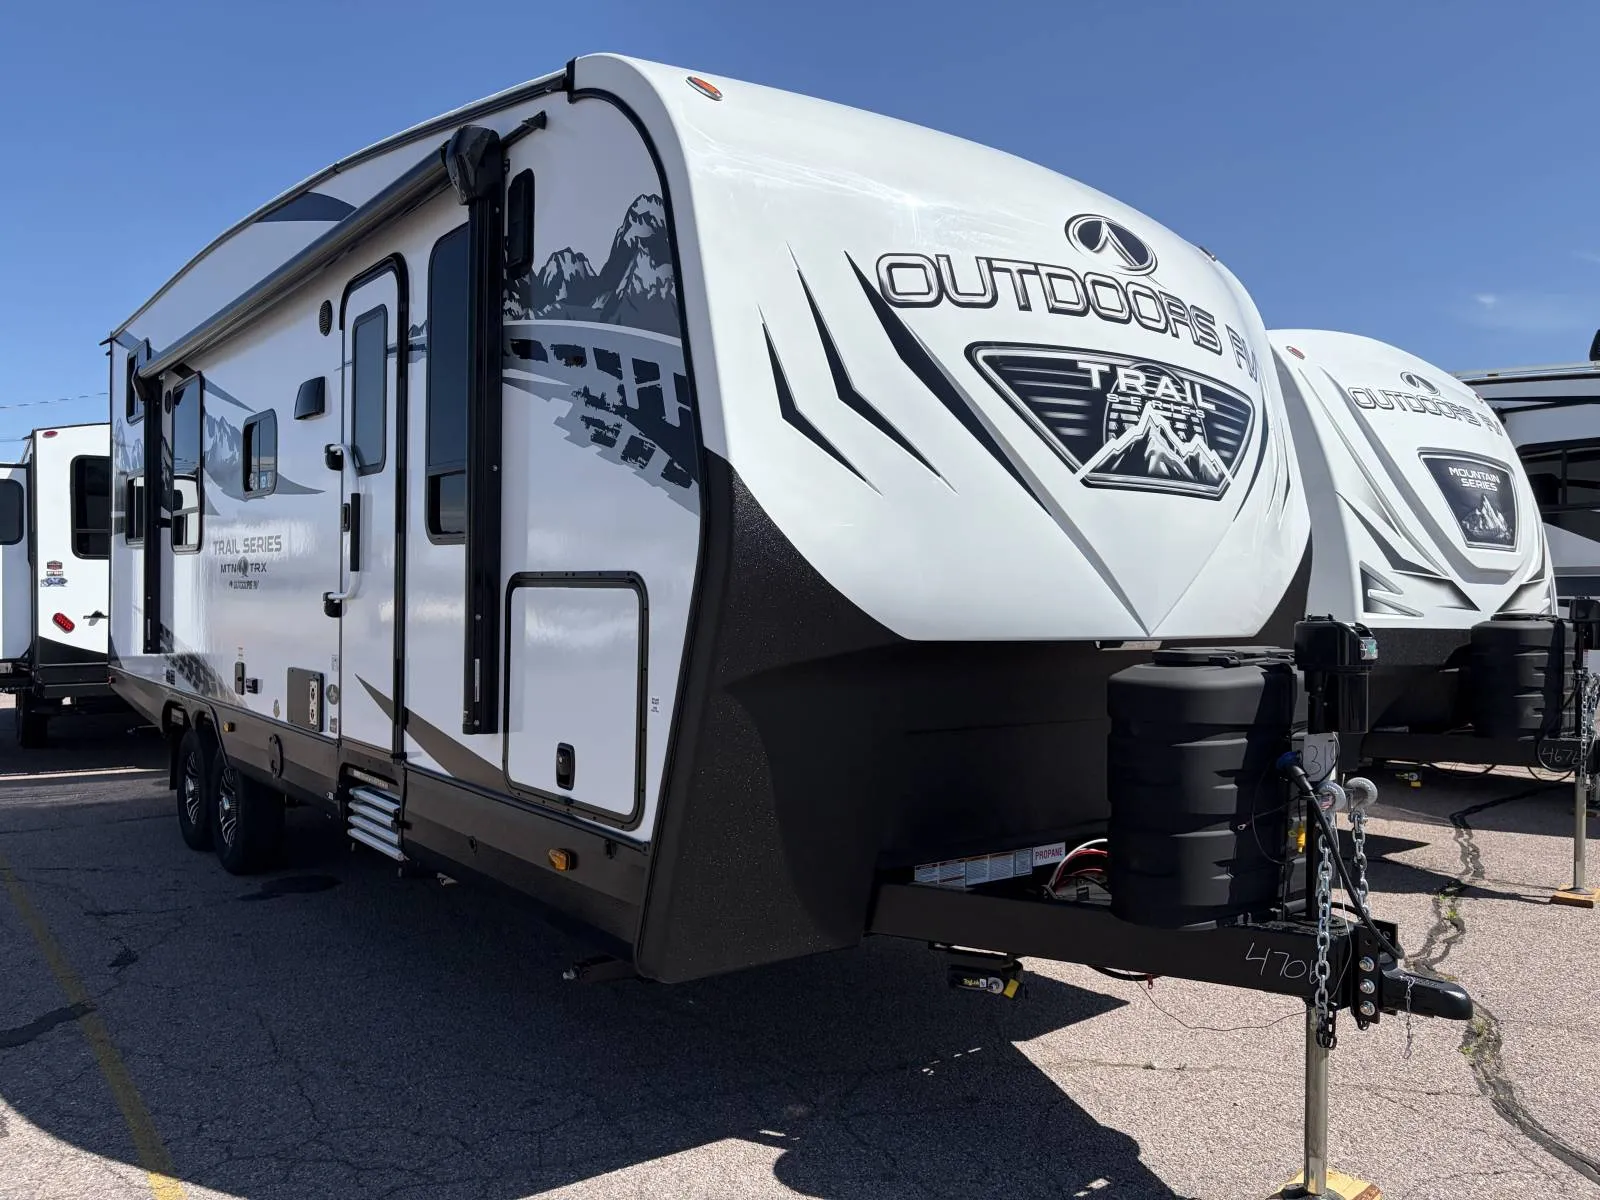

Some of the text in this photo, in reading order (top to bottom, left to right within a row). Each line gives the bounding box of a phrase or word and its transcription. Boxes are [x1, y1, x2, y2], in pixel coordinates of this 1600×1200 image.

[876, 253, 1223, 356] OUTDOORS
[1076, 360, 1217, 412] TRAIL
[1106, 392, 1206, 419] SERIES
[1347, 387, 1482, 427] OUTDOORS
[1448, 466, 1501, 484] MOUNTAIN
[1461, 477, 1498, 492] SERIES
[213, 534, 282, 555] TRAIL SERIES
[249, 562, 267, 573] TRX
[1035, 847, 1063, 861] PROPANE
